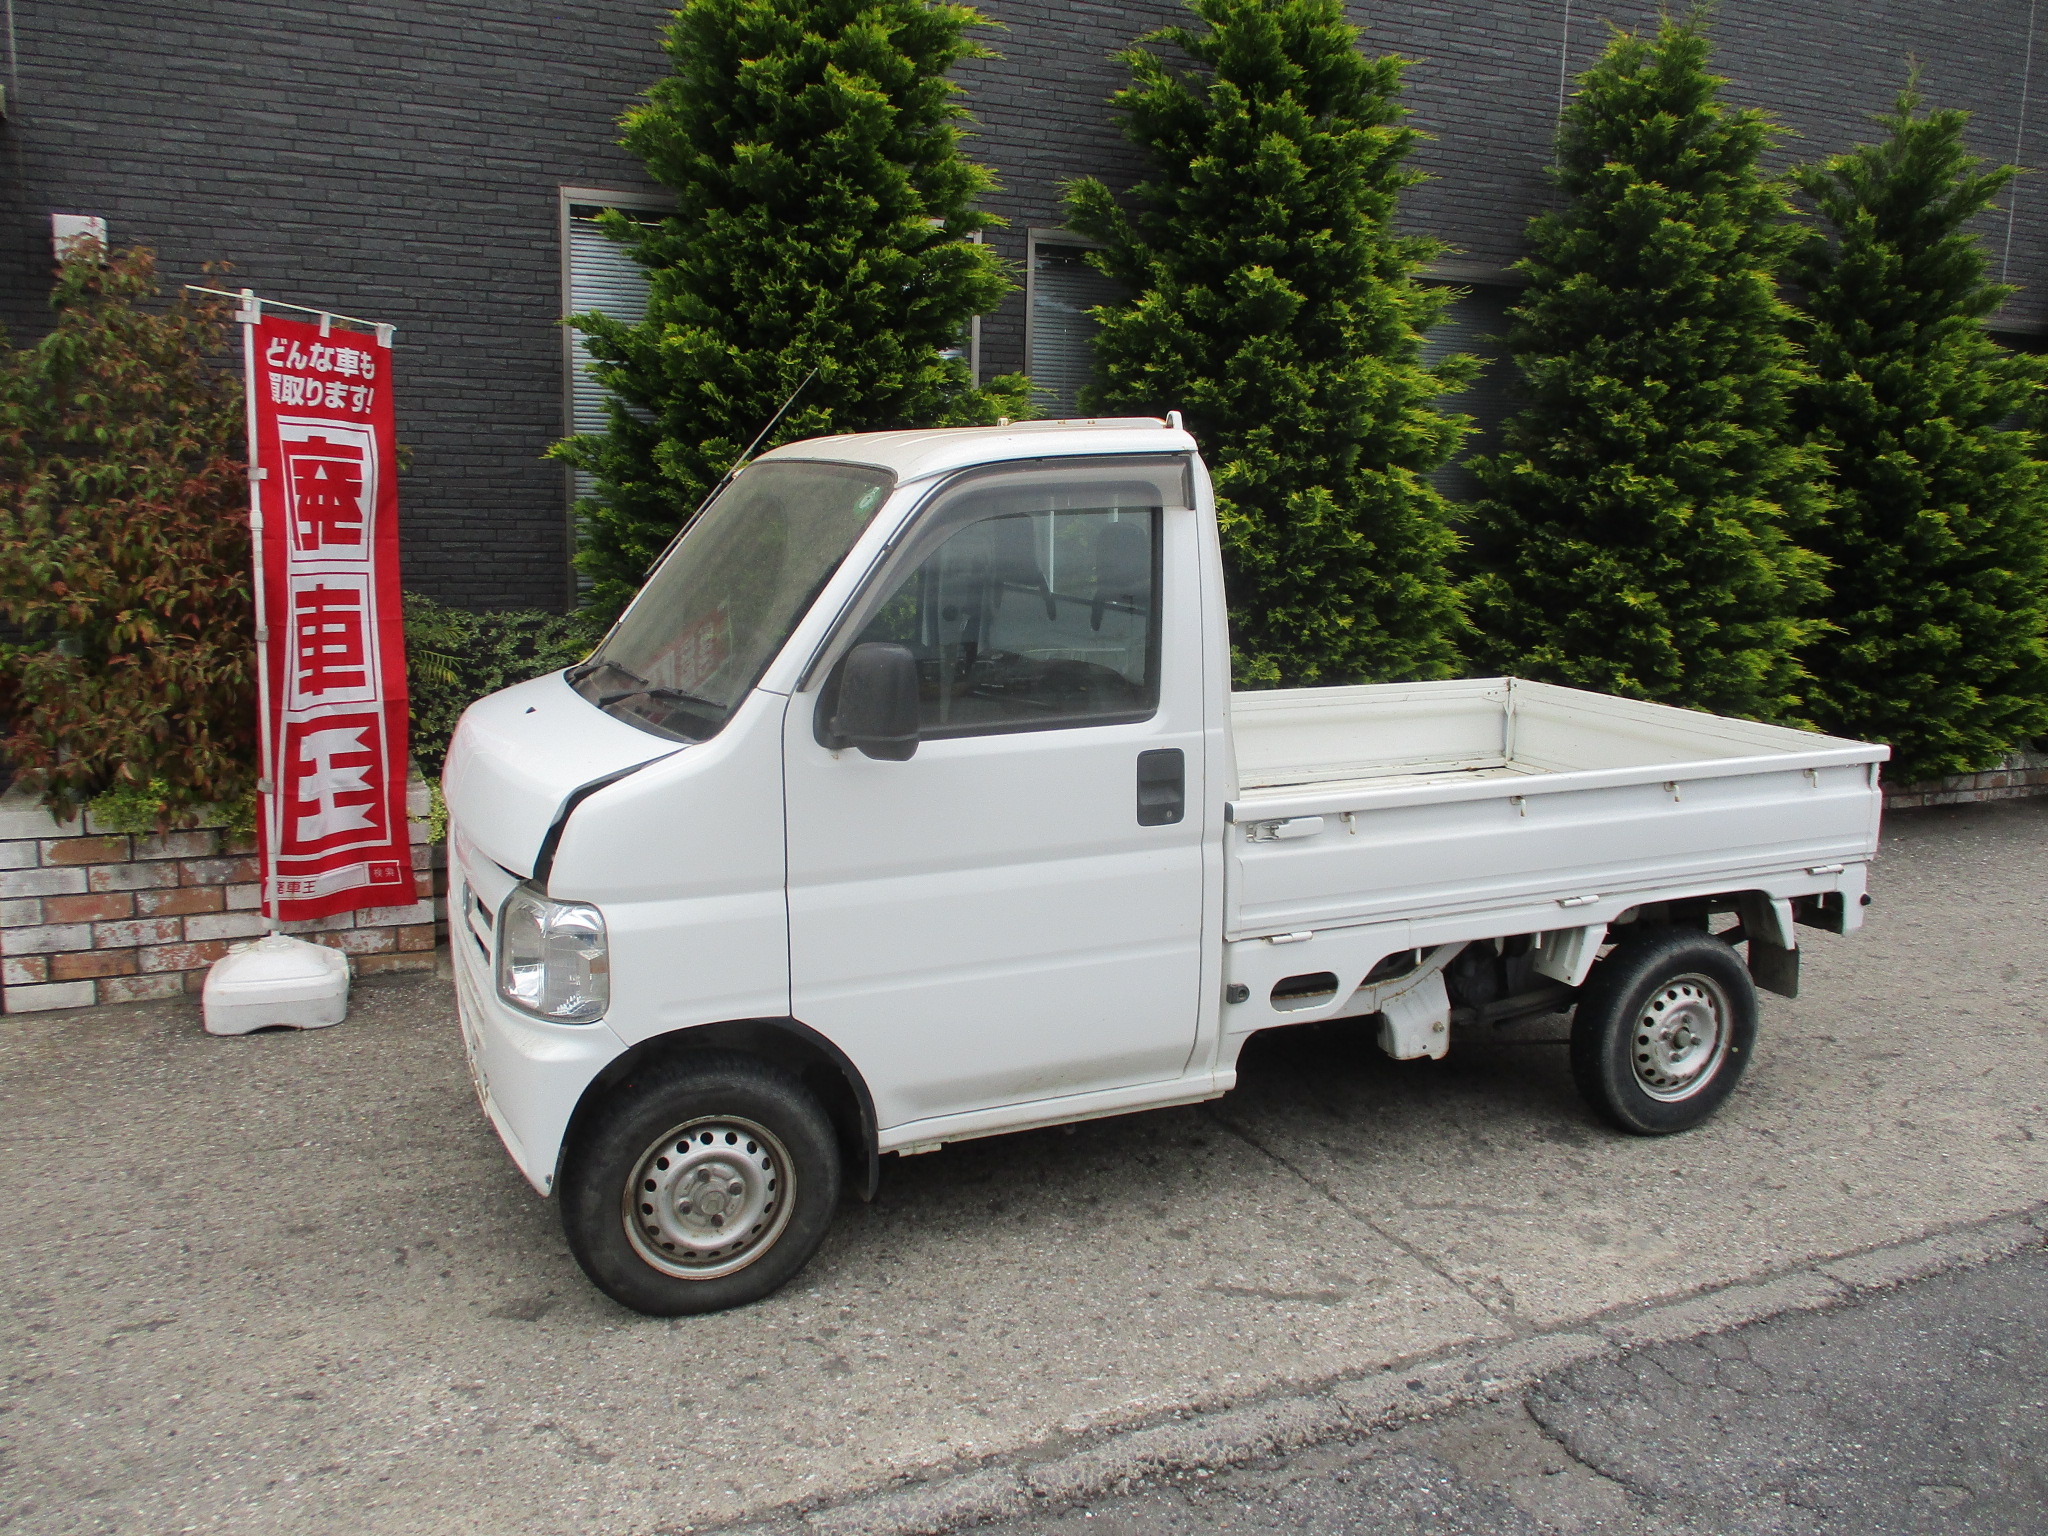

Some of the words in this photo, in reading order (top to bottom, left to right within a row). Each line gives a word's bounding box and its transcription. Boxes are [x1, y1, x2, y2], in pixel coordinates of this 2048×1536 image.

[265, 336, 375, 380] どんな車も
[281, 435, 379, 842] 廃車王
